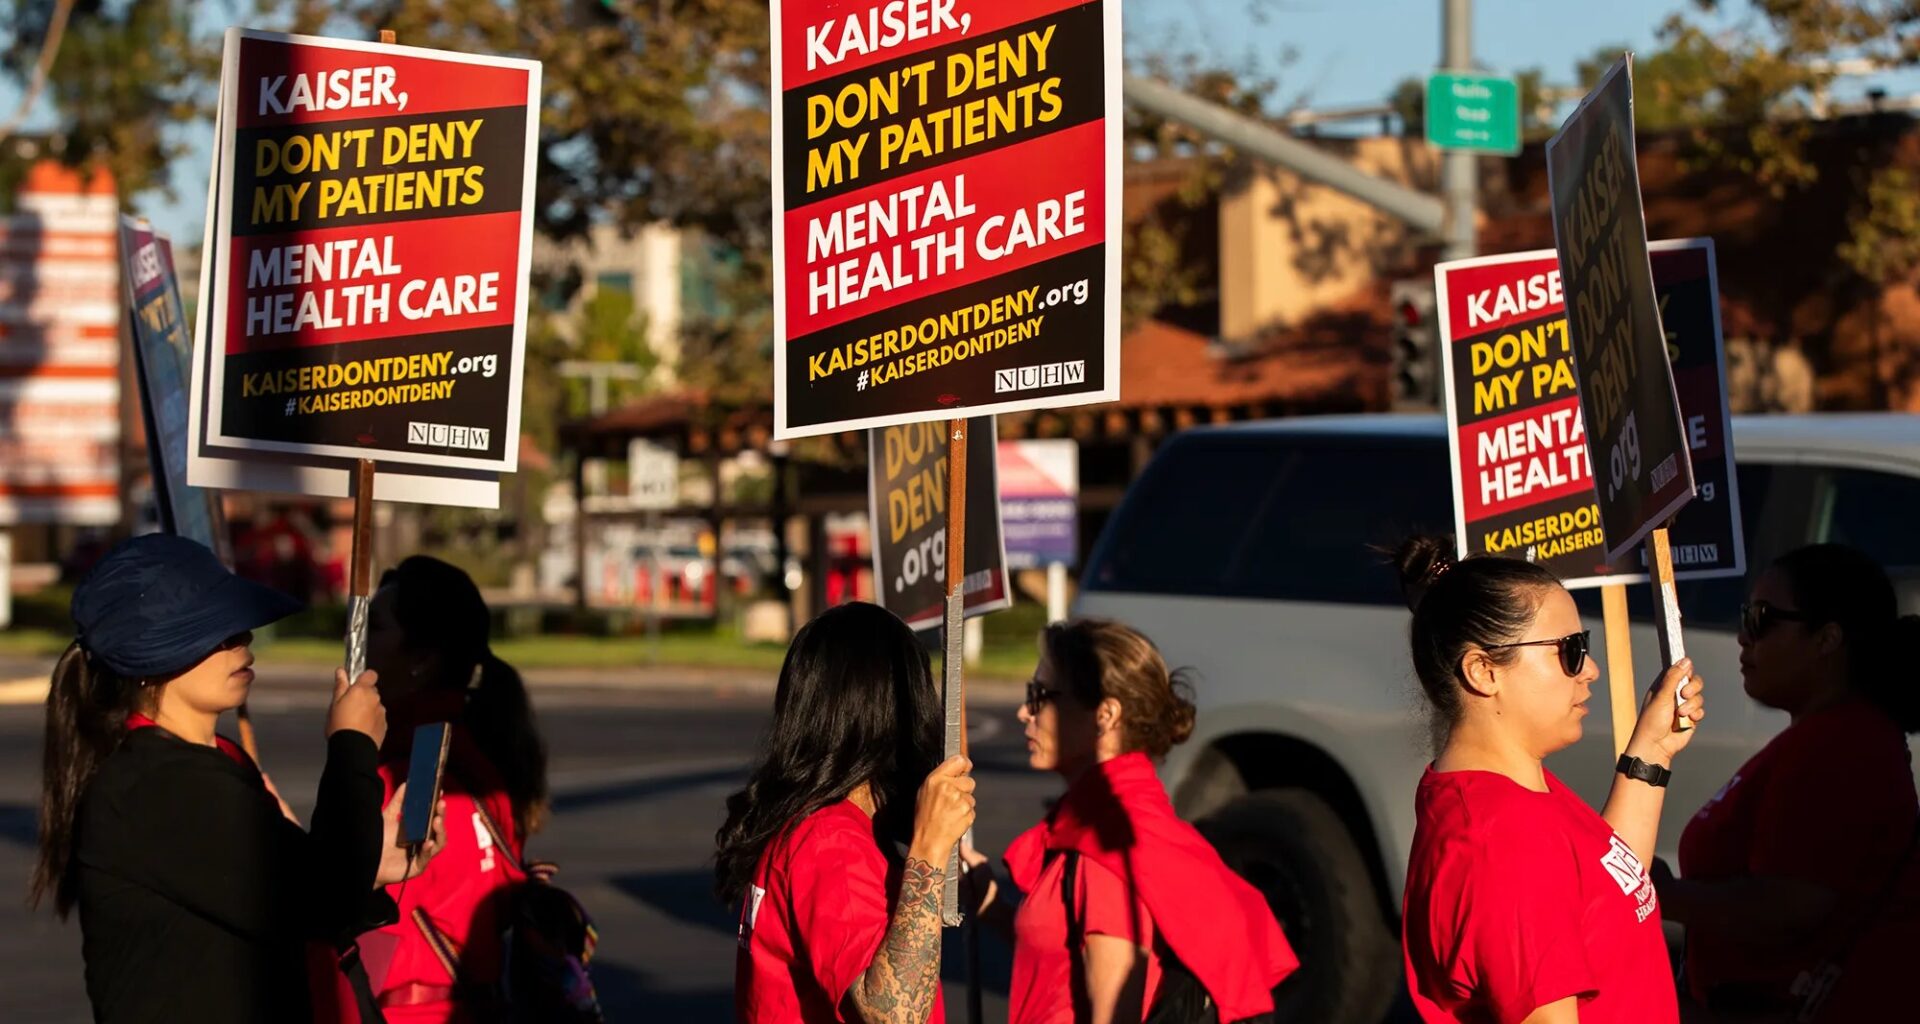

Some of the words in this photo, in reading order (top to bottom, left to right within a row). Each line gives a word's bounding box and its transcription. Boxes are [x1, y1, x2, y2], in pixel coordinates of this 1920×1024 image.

[806, 0, 972, 72] KAISER,
[258, 65, 409, 116] KAISER,
[807, 60, 936, 140] DON'T
[946, 24, 1057, 98] DENY
[255, 128, 375, 177] DON'T
[382, 119, 484, 166] DENY
[806, 132, 870, 193] MY
[880, 77, 1063, 171] PATIENTS
[251, 181, 311, 225] MY
[318, 165, 485, 219] PATIENTS
[806, 174, 976, 264] MENTAL
[1564, 119, 1625, 284] KAISER
[247, 235, 402, 289] MENTAL
[809, 226, 965, 316] HEALTH
[975, 189, 1086, 261] CARE
[246, 283, 391, 337] HEALTH
[398, 272, 499, 320] CARE
[1467, 269, 1564, 328] KAISE
[1576, 216, 1632, 363] DONT
[809, 278, 1089, 382] KAISERDONTDENY.org
[856, 316, 1045, 391] #KAISERDONTDENY
[242, 351, 498, 397] KAISERDONTDENY.org
[284, 380, 456, 416] #KAISERDONTDENY
[996, 361, 1085, 393] NUHW
[1474, 370, 1524, 415] MY
[1590, 302, 1638, 440] DENY
[408, 422, 490, 450] NUHW
[885, 421, 946, 481] DON
[1608, 409, 1642, 502] .org
[888, 456, 947, 545] DEN
[1526, 527, 1604, 563] #KAISERD
